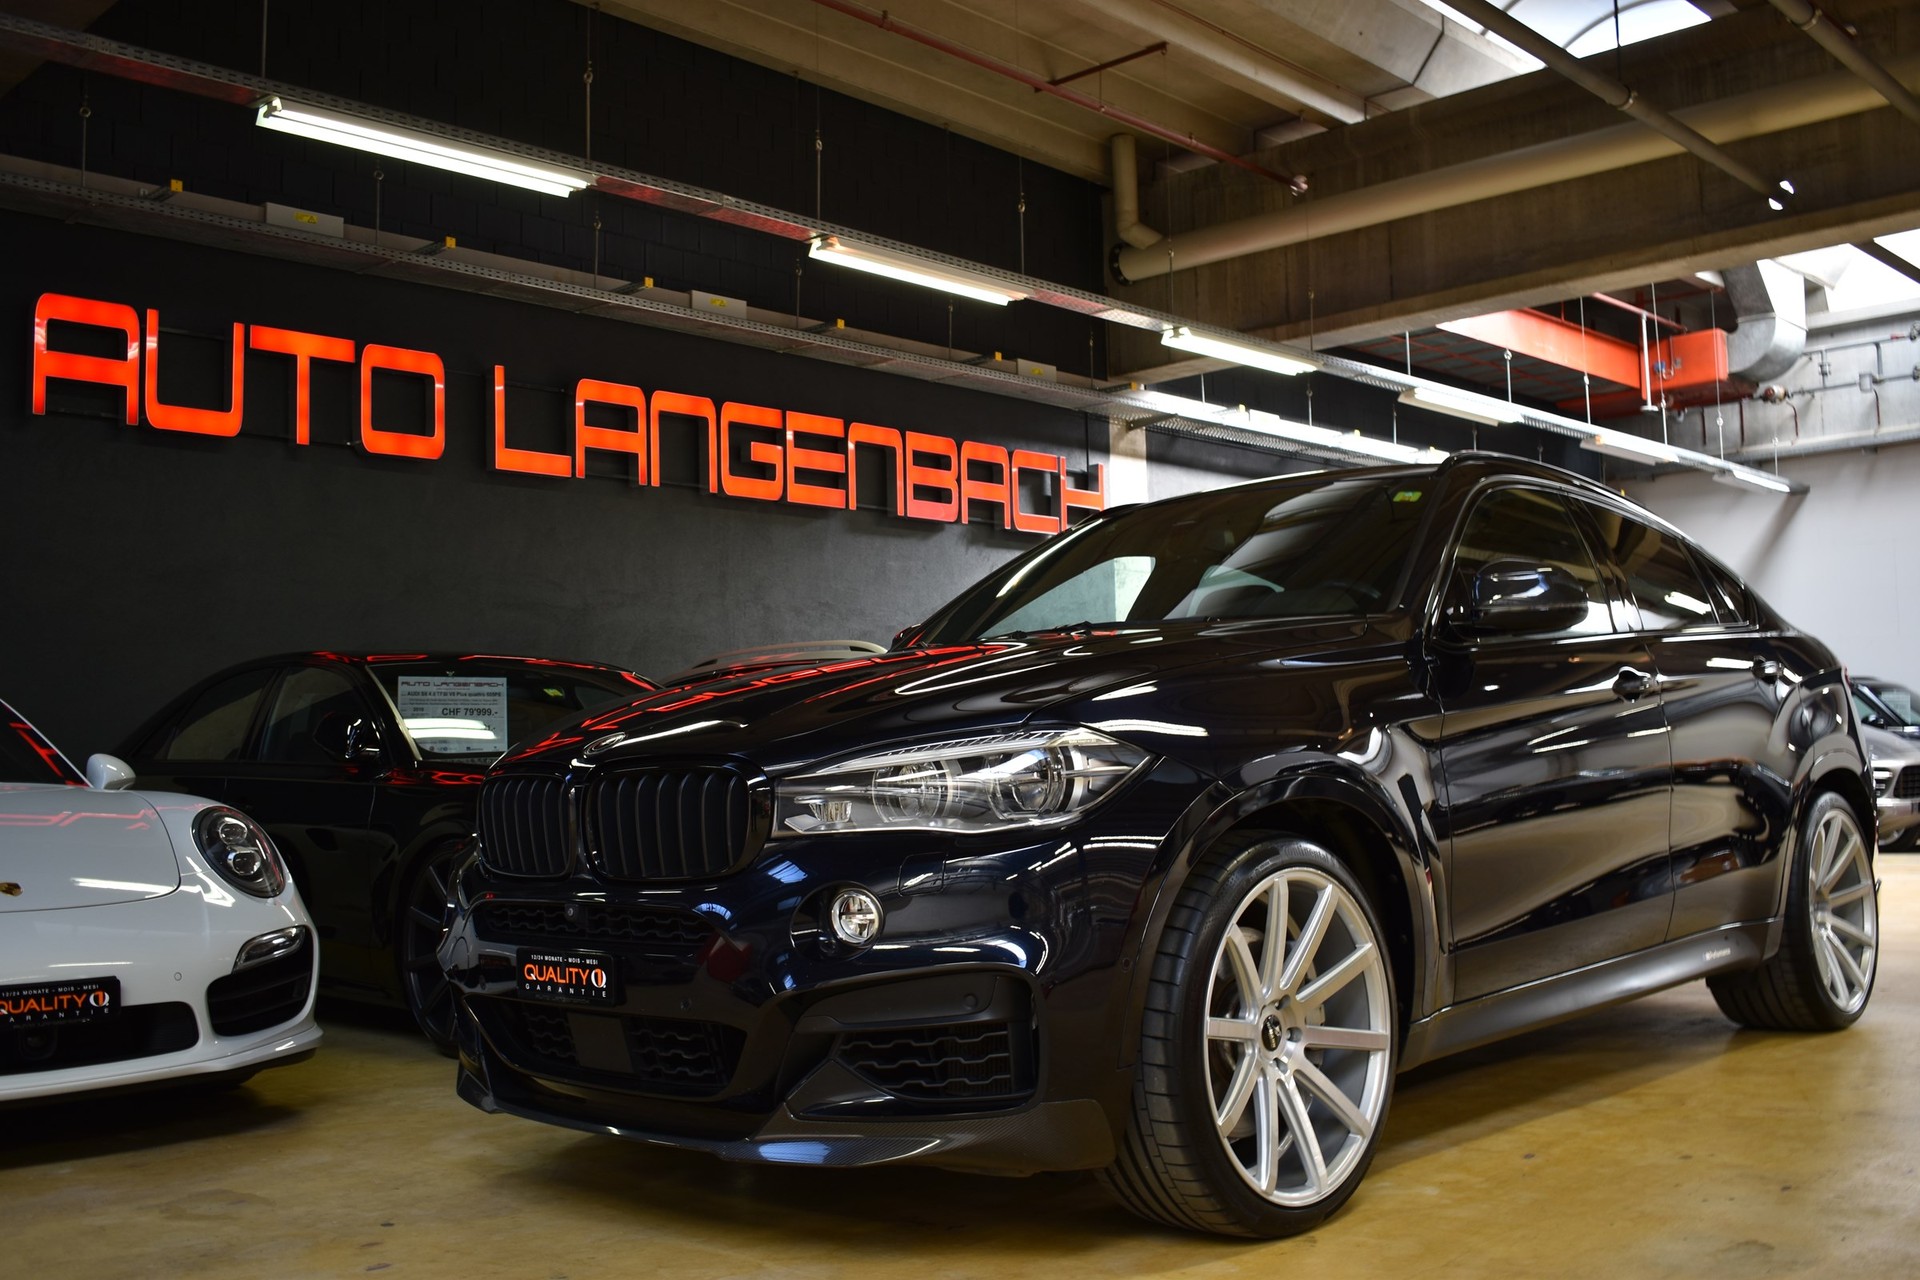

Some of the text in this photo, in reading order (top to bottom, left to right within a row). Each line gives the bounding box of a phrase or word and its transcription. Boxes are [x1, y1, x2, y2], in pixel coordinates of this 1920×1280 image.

[33, 292, 1105, 536] AUTO LANGENBACH
[442, 708, 461, 716] CHF
[544, 955, 563, 963] MONATE
[524, 963, 590, 986] QUALITY
[22, 988, 49, 996] MONATE
[525, 983, 607, 998] GARANTIE
